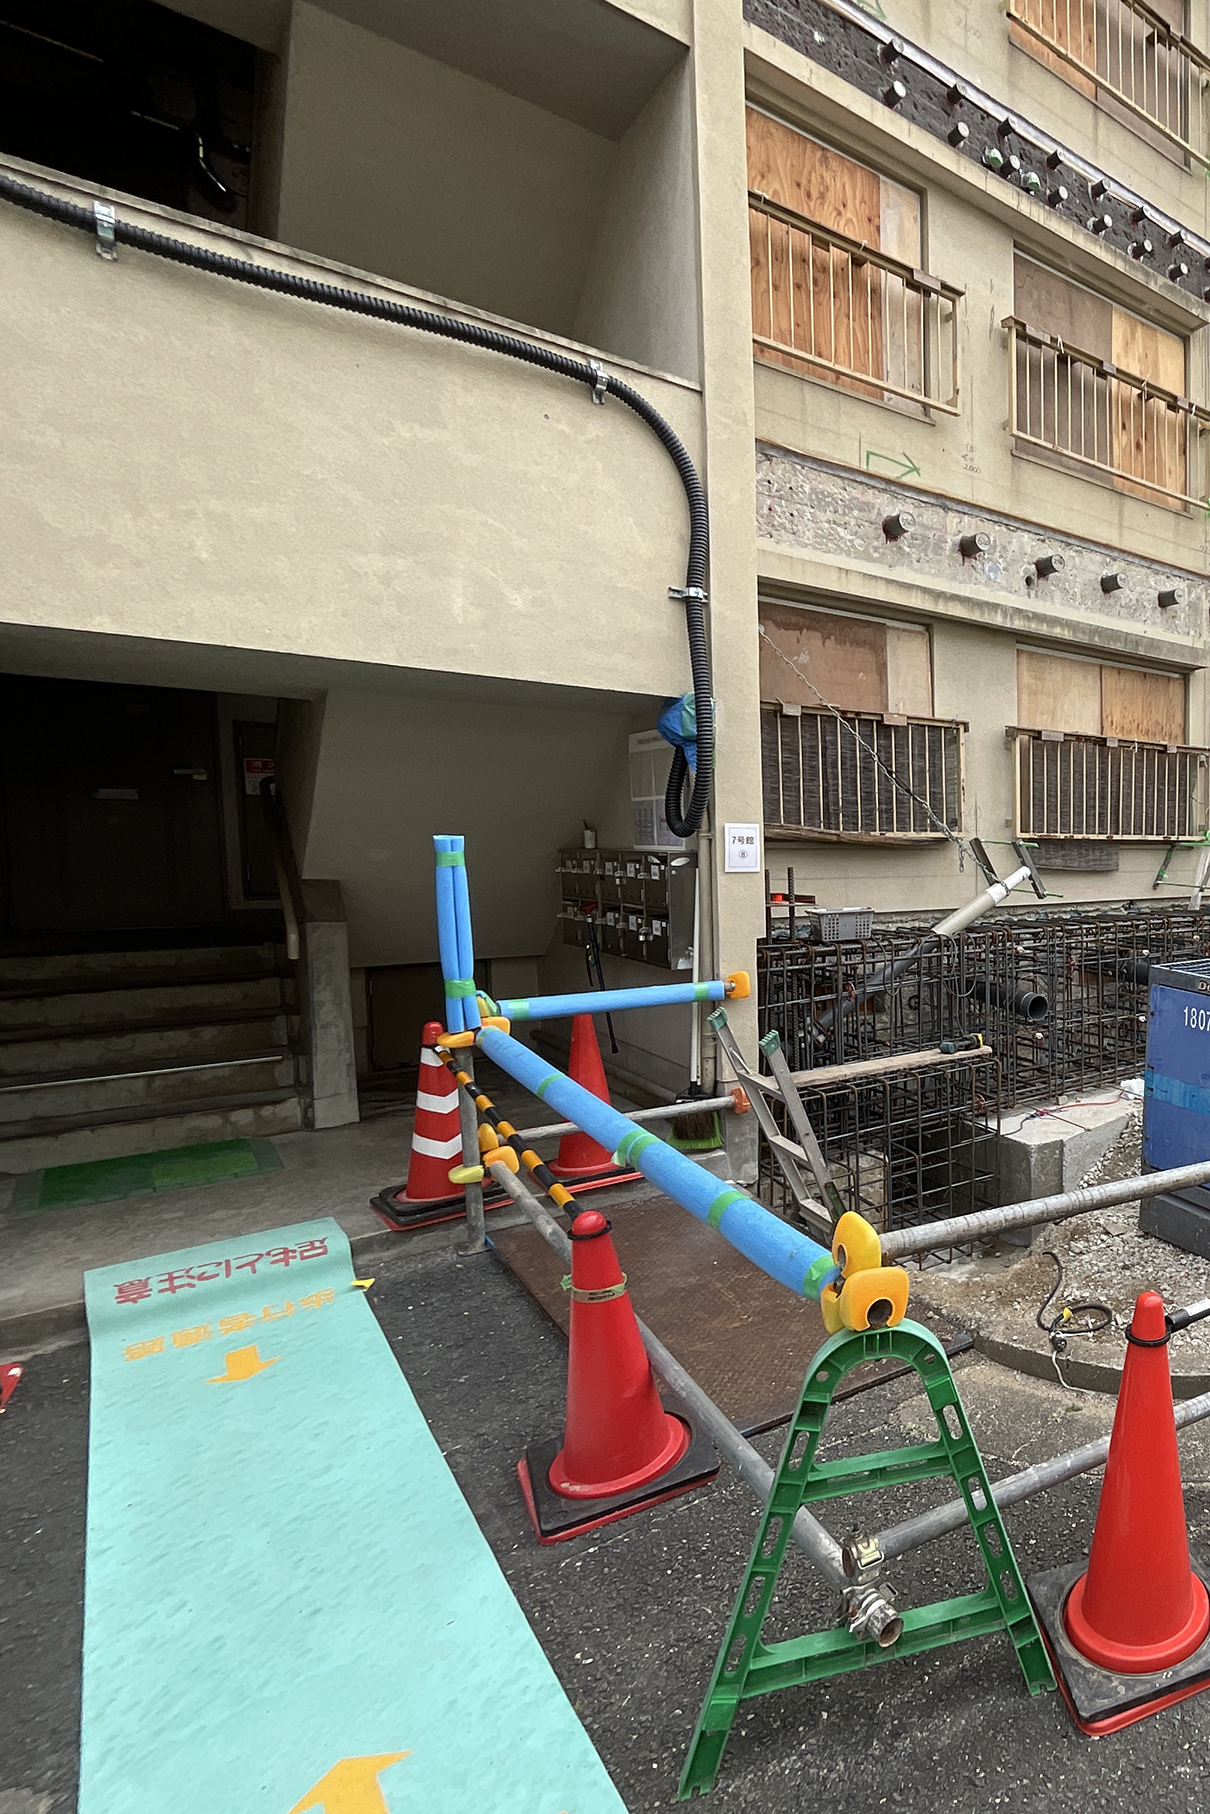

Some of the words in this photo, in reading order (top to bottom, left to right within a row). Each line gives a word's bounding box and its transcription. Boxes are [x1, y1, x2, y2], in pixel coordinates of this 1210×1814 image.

[731, 836, 755, 845] 7号館
[113, 1236, 329, 1305] 足もとに注意
[122, 1288, 336, 1362] 歩行者通路
